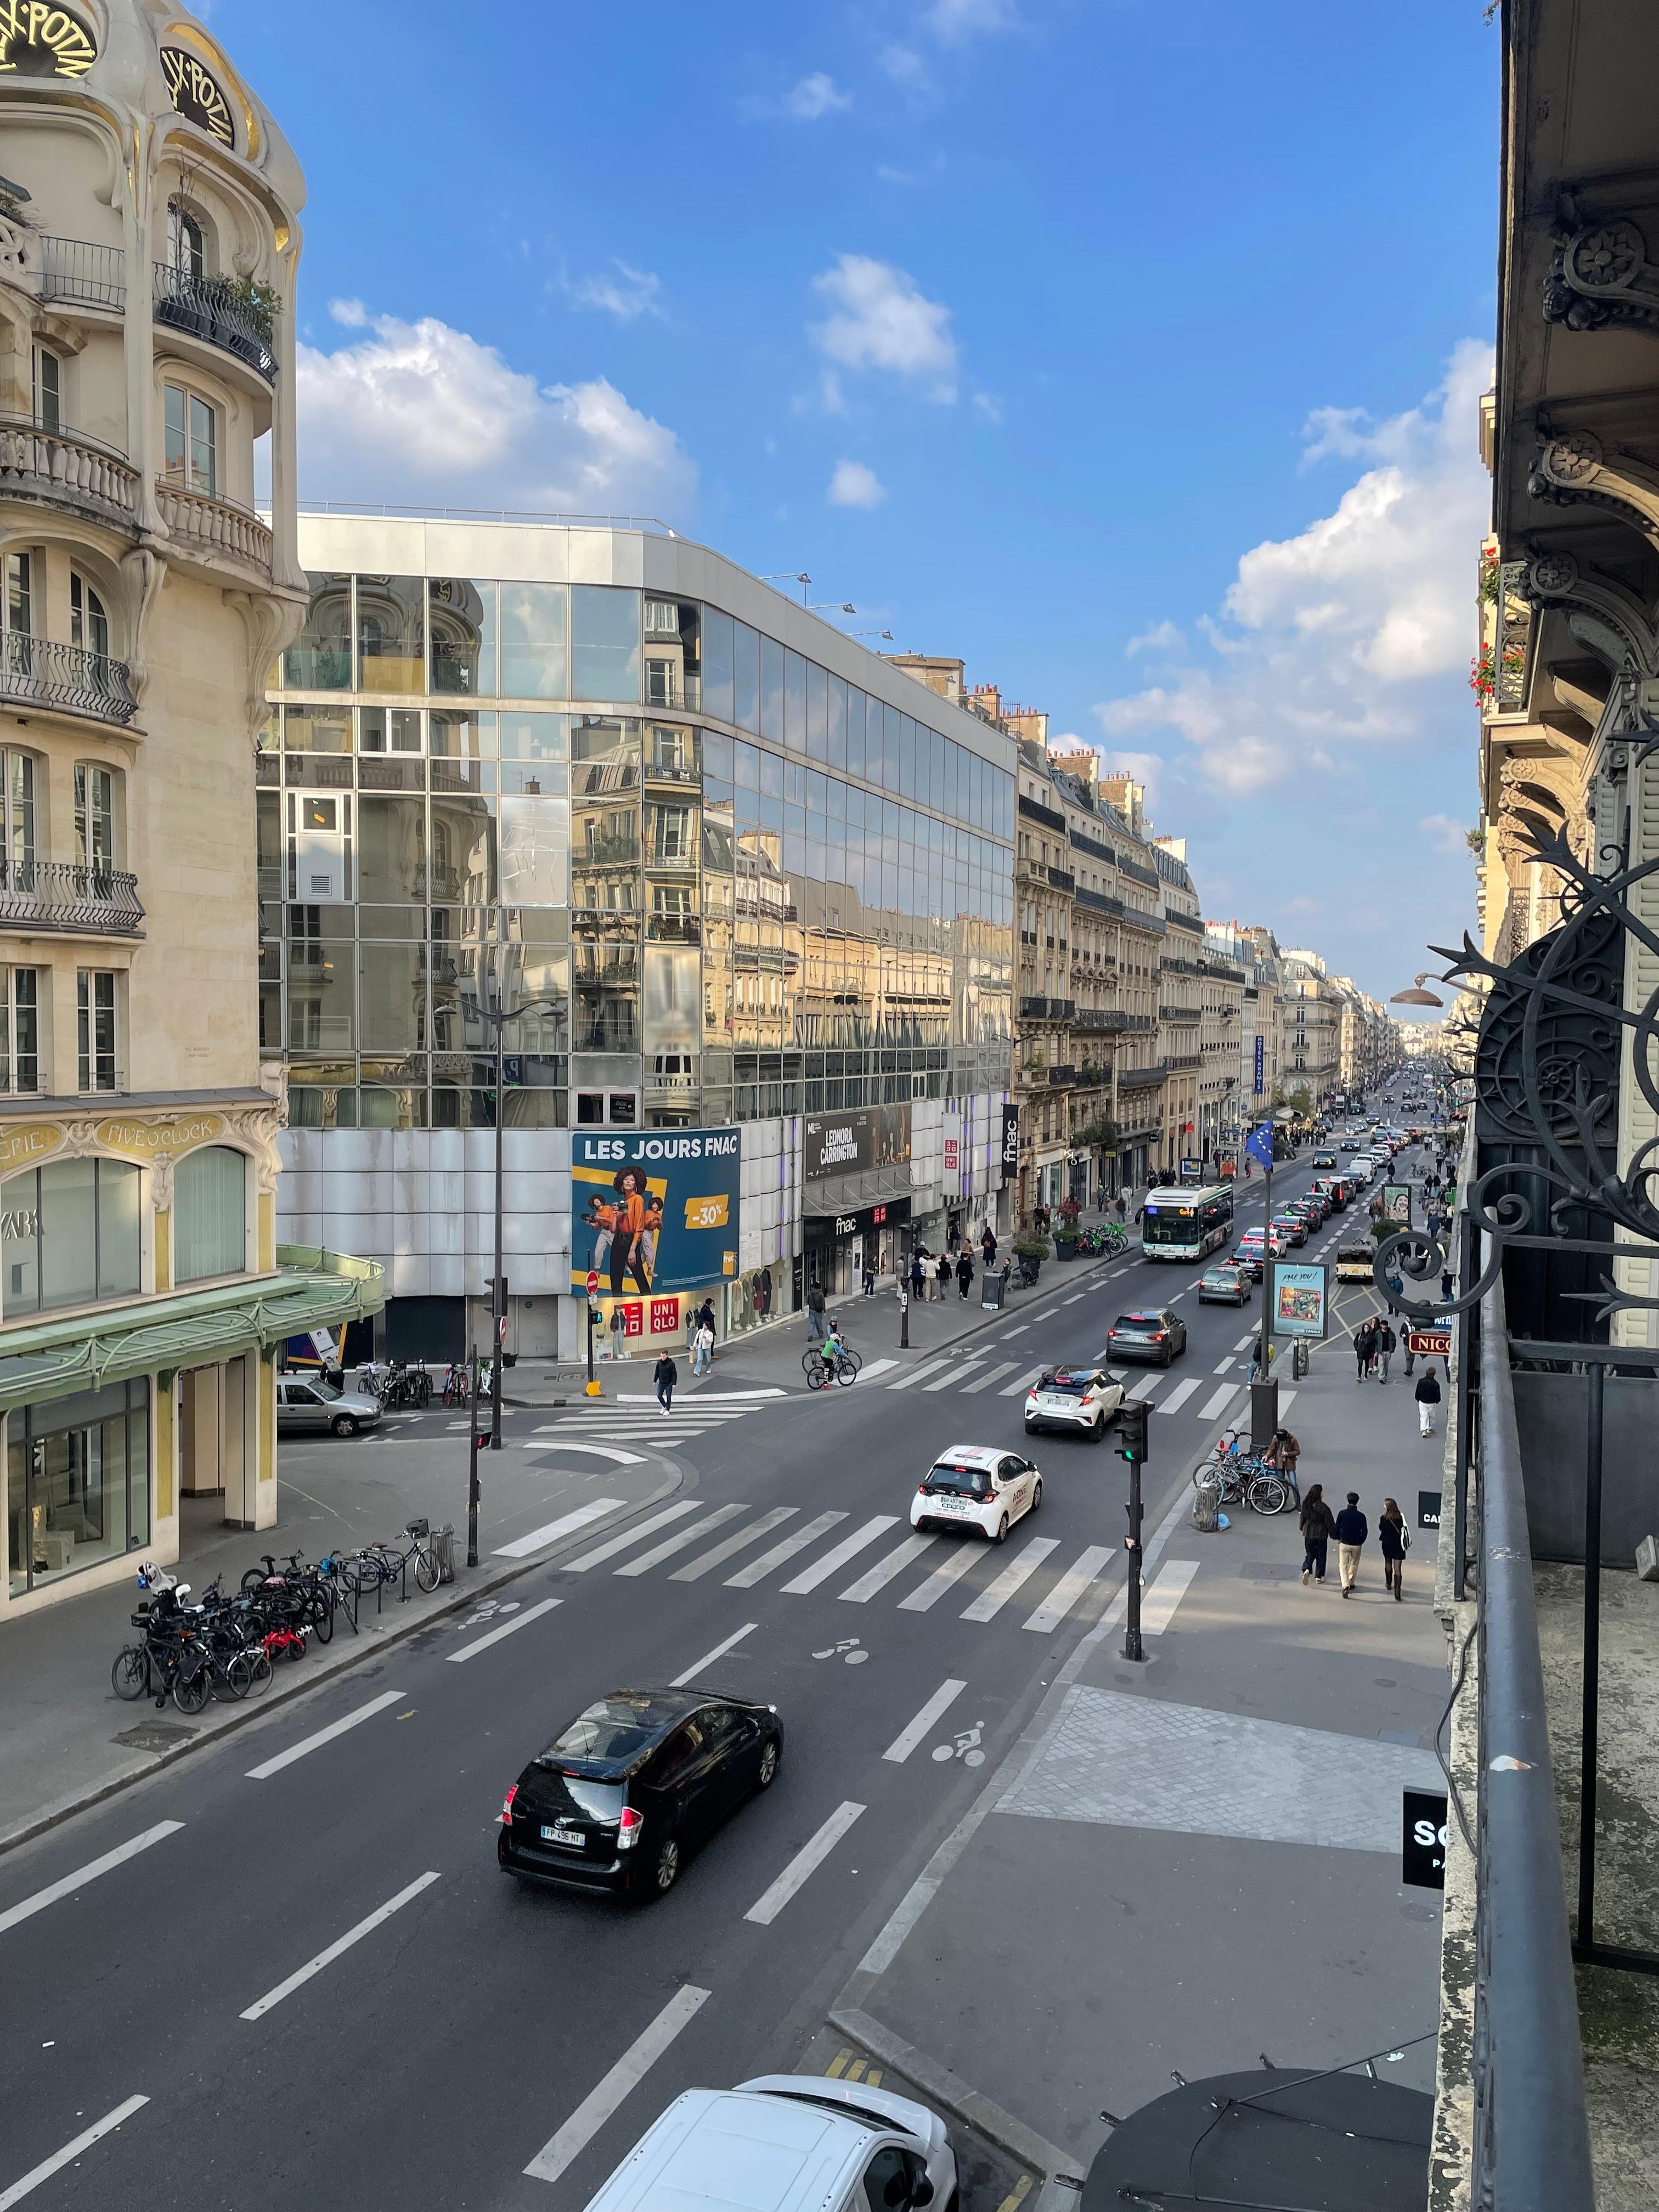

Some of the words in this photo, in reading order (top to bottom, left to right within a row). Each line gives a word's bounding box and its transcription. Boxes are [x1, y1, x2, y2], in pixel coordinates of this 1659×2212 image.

[107, 1125, 145, 1147] FIVE
[146, 1119, 213, 1146] O'CLOCK
[825, 1127, 853, 1147] LEONORA
[1003, 1120, 1018, 1162] fnac
[585, 1140, 626, 1160] LES
[631, 1138, 701, 1160] JOURS
[704, 1135, 737, 1157] FNAC
[820, 1142, 857, 1165] CARRINGTON
[836, 1217, 856, 1235] fnac
[654, 1303, 673, 1316] UNI
[653, 1316, 675, 1331] QLO
[1433, 1859, 1445, 1869] P
